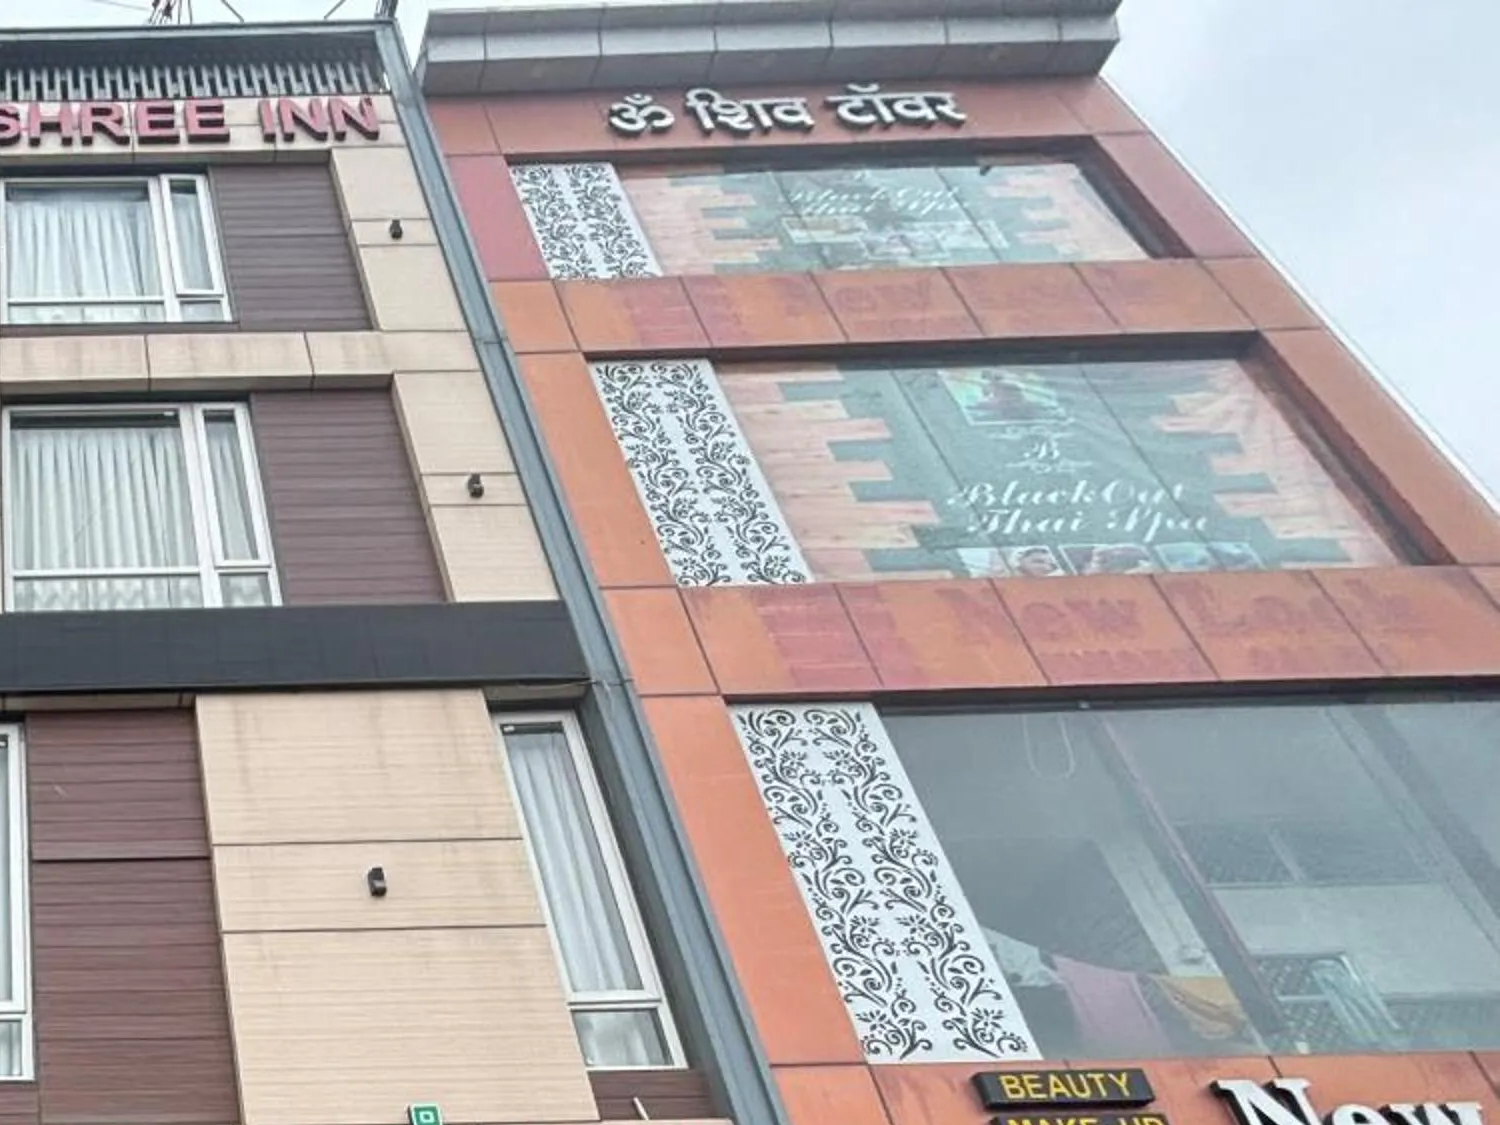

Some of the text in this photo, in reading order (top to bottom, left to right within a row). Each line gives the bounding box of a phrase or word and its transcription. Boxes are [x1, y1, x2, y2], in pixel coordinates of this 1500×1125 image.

[259, 96, 380, 142] INN
[684, 88, 815, 134] शिव
[827, 83, 967, 127] टॉवर
[999, 1071, 1131, 1099] BEAUTY
